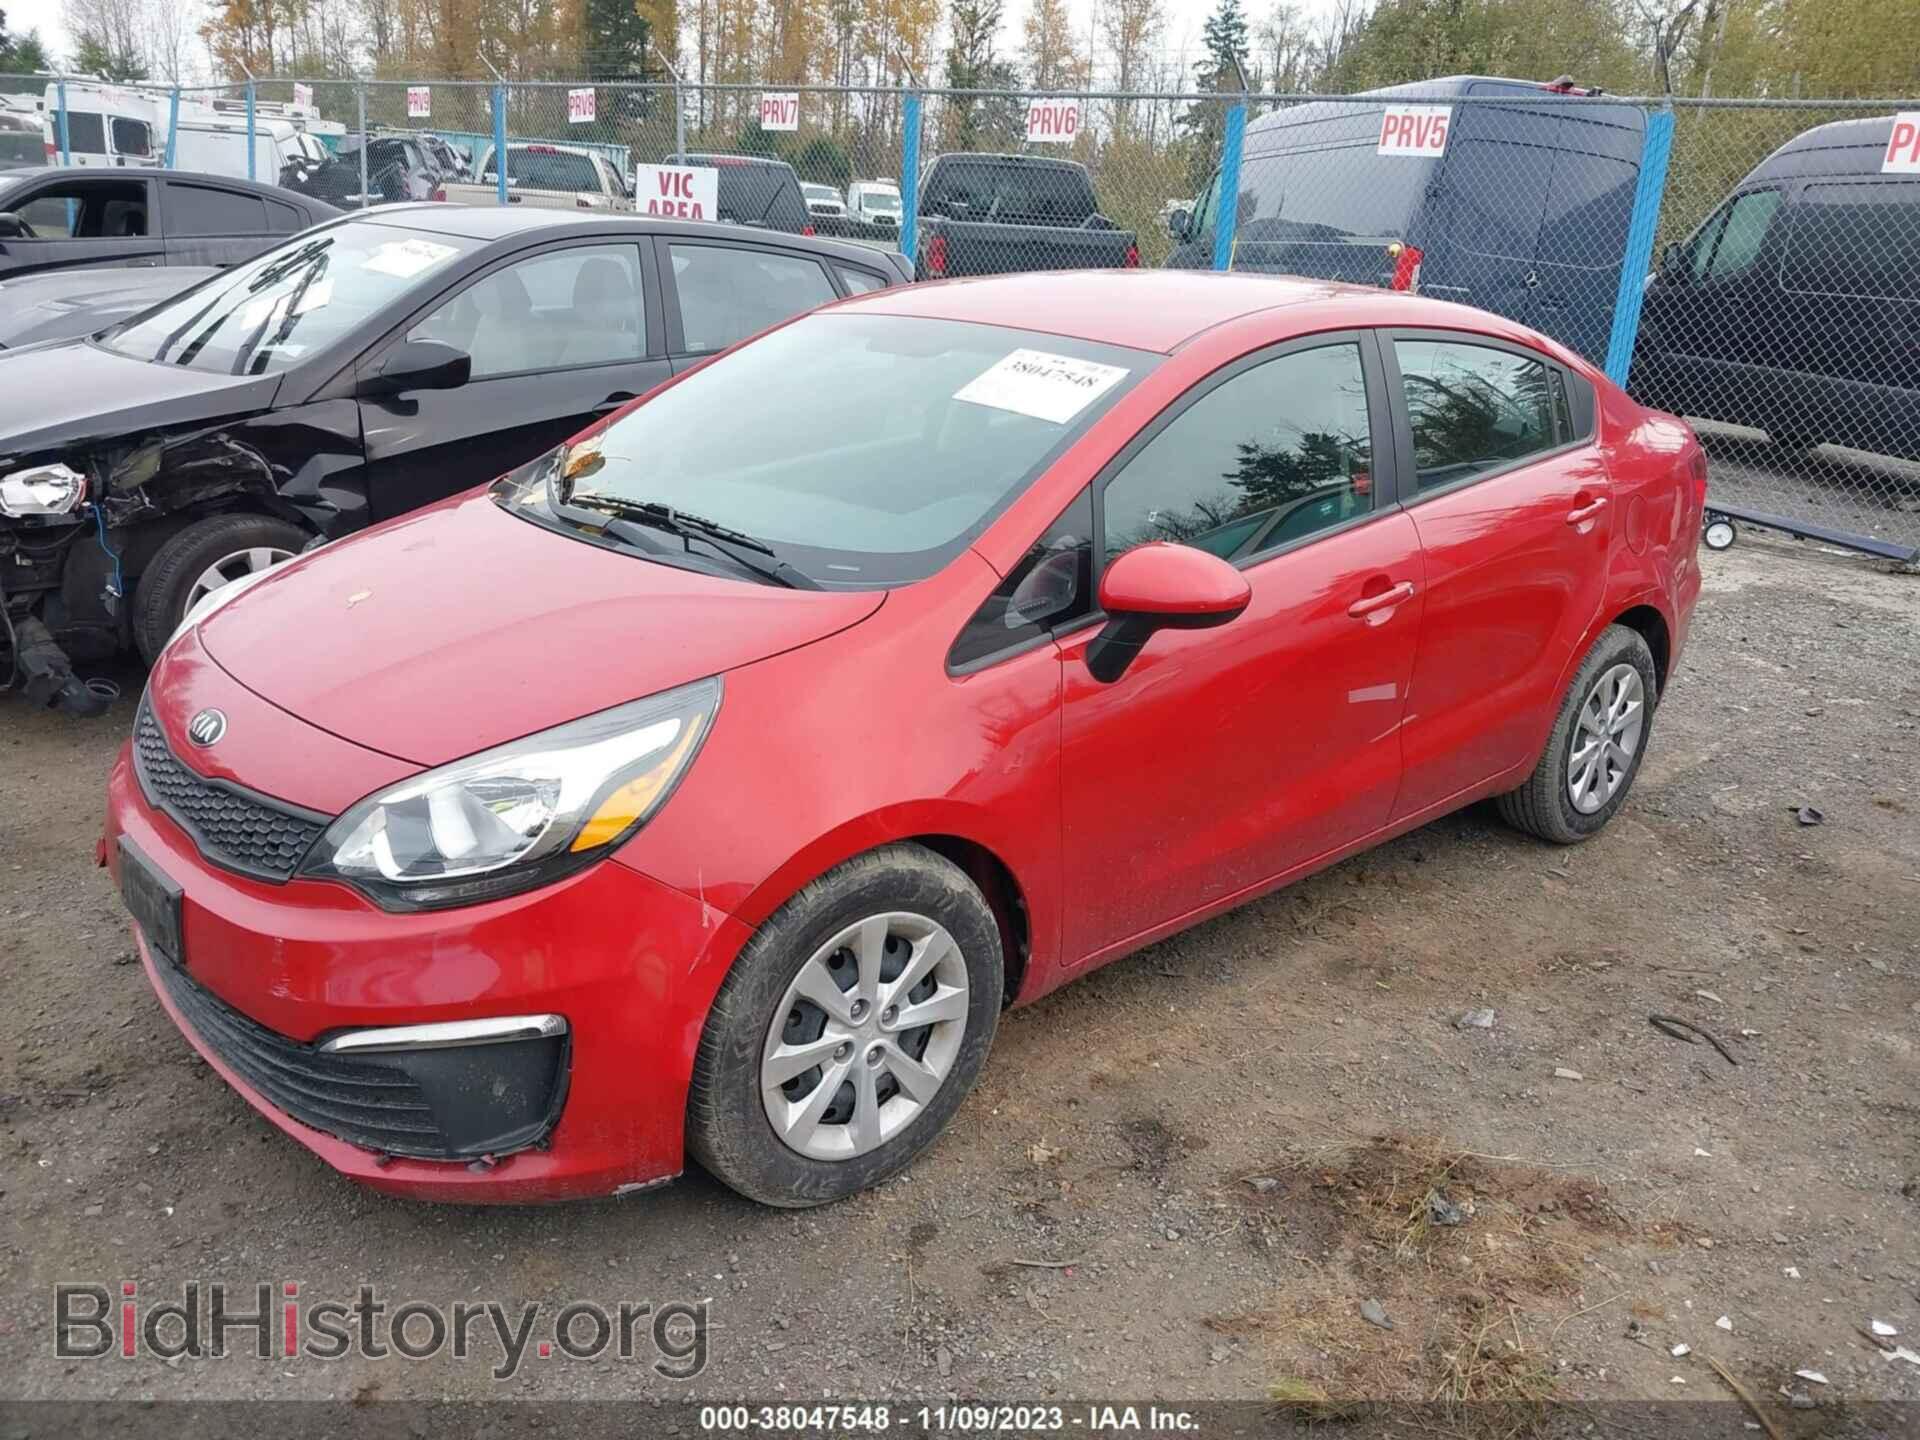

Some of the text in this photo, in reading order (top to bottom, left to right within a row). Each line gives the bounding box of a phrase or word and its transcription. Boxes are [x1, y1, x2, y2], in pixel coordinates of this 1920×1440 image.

[408, 92, 430, 112] PRV9
[569, 94, 594, 117] PRV8
[763, 100, 797, 124] PRV7
[1029, 106, 1076, 134] PRV6
[1381, 114, 1448, 148] PRV5
[658, 171, 693, 198] VIC
[649, 199, 703, 219] AREA
